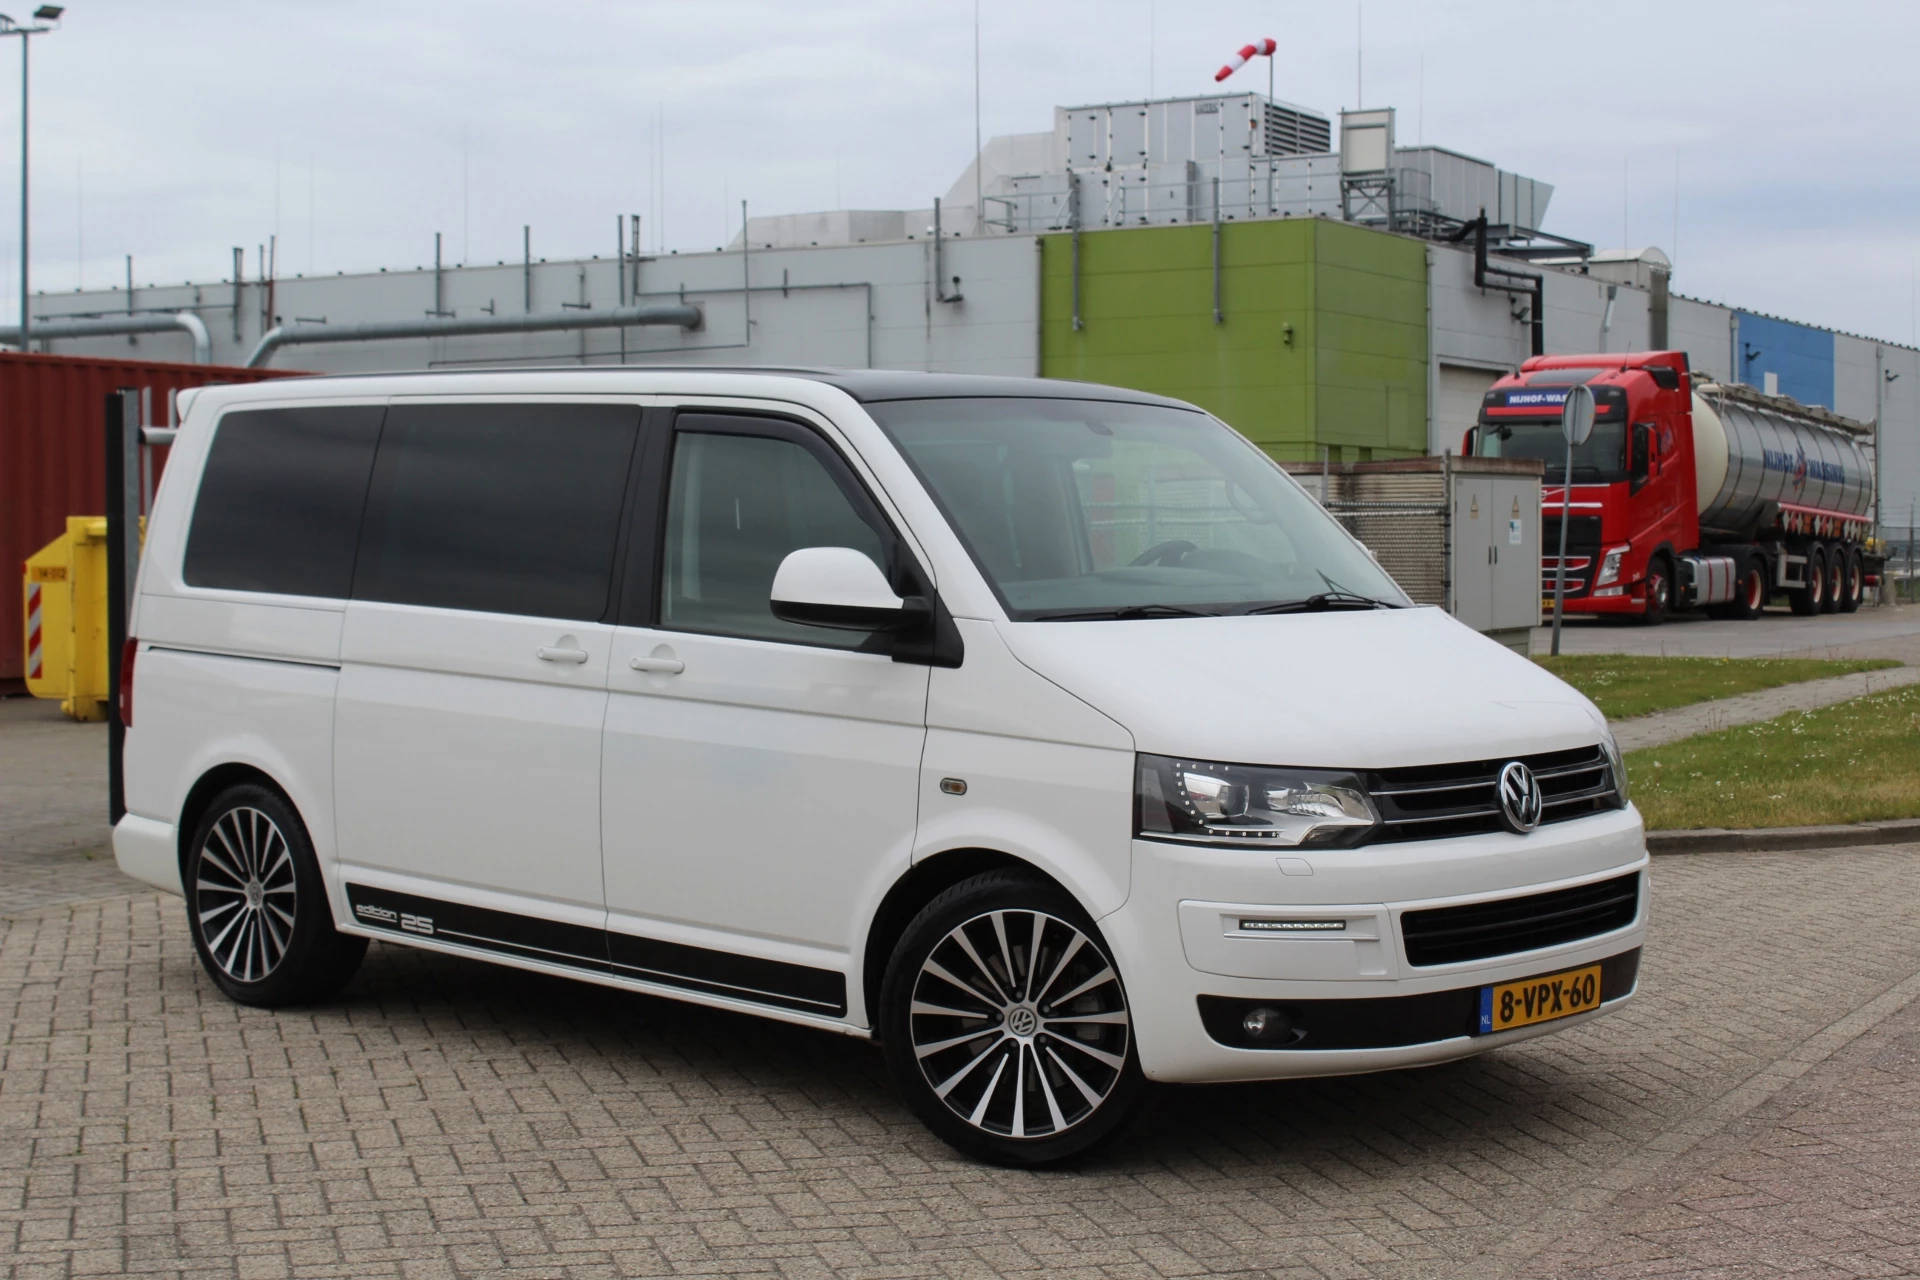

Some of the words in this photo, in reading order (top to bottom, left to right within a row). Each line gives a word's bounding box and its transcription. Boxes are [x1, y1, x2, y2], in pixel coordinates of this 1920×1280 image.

[400, 913, 434, 935] 25
[1500, 973, 1595, 1023] 8-VPX-60
[1481, 1015, 1491, 1025] NL
